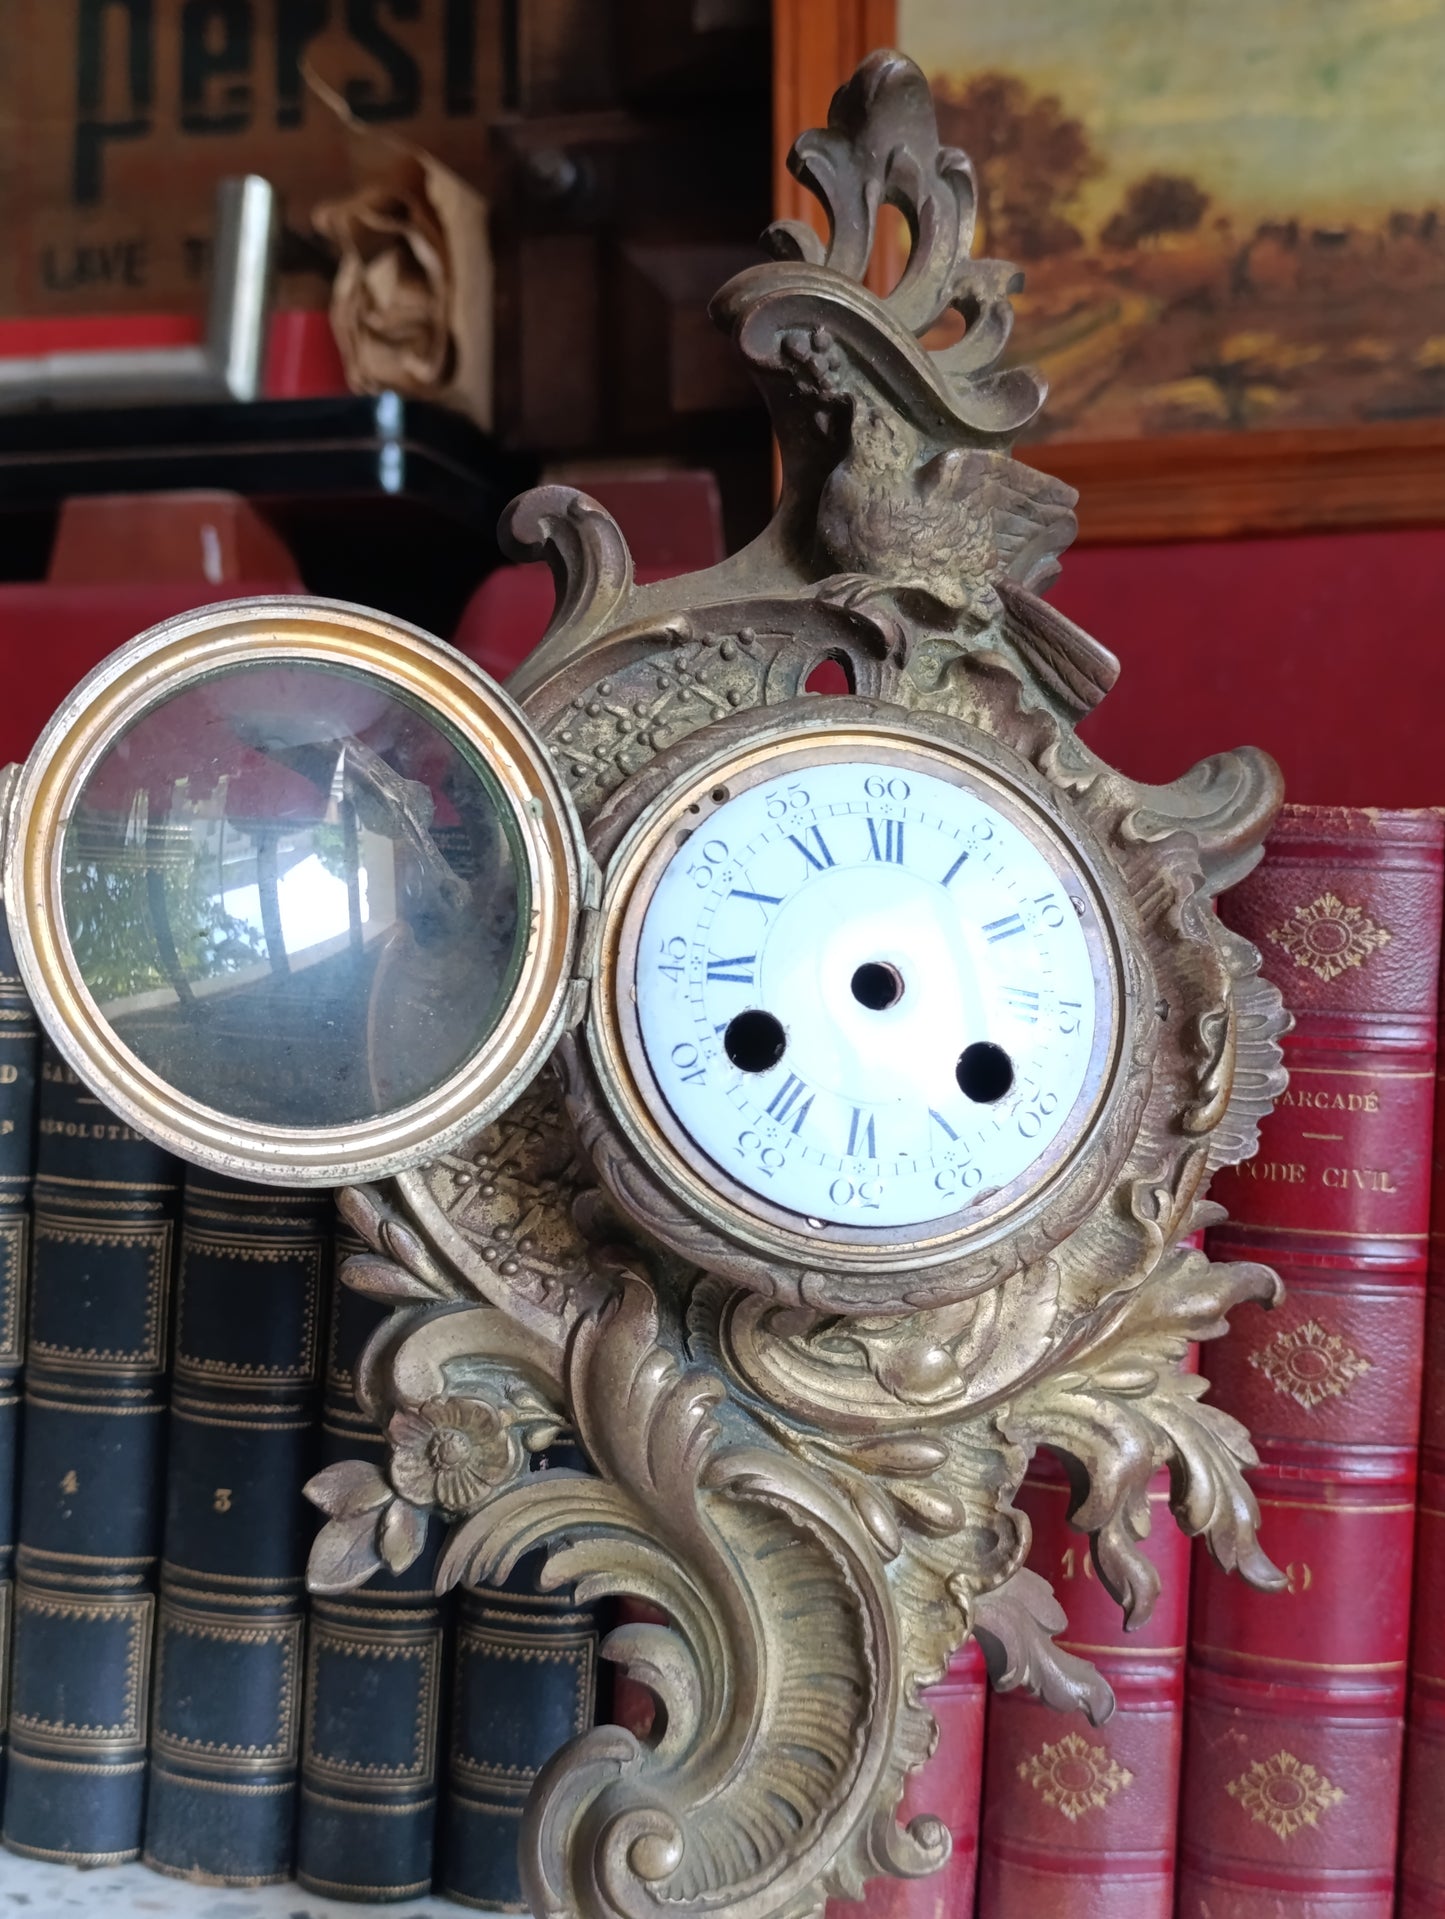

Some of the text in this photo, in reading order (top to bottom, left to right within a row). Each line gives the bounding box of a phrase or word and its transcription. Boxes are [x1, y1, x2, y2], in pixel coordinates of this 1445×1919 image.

[765, 783, 811, 819] 55
[863, 776, 911, 801] 60
[863, 817, 906, 866] XII
[973, 817, 995, 841] 5
[686, 839, 730, 890] 50
[788, 824, 840, 881] XI
[940, 851, 970, 887] I
[729, 872, 787, 926] X
[1033, 893, 1065, 929] 10
[982, 913, 1026, 944] II
[657, 935, 689, 984] 45
[706, 950, 757, 985] IX
[1059, 1000, 1083, 1036] 15
[670, 1043, 707, 1087] 40
[764, 1069, 816, 1137] VII
[1017, 1088, 1059, 1138] 20
[1273, 1089, 1380, 1113] ARCADÉ
[846, 1106, 877, 1159] VI
[735, 1130, 786, 1178] 35
[829, 1178, 884, 1209] 30
[934, 1160, 983, 1199] 25
[1235, 1160, 1397, 1194] CODE CIVIL
